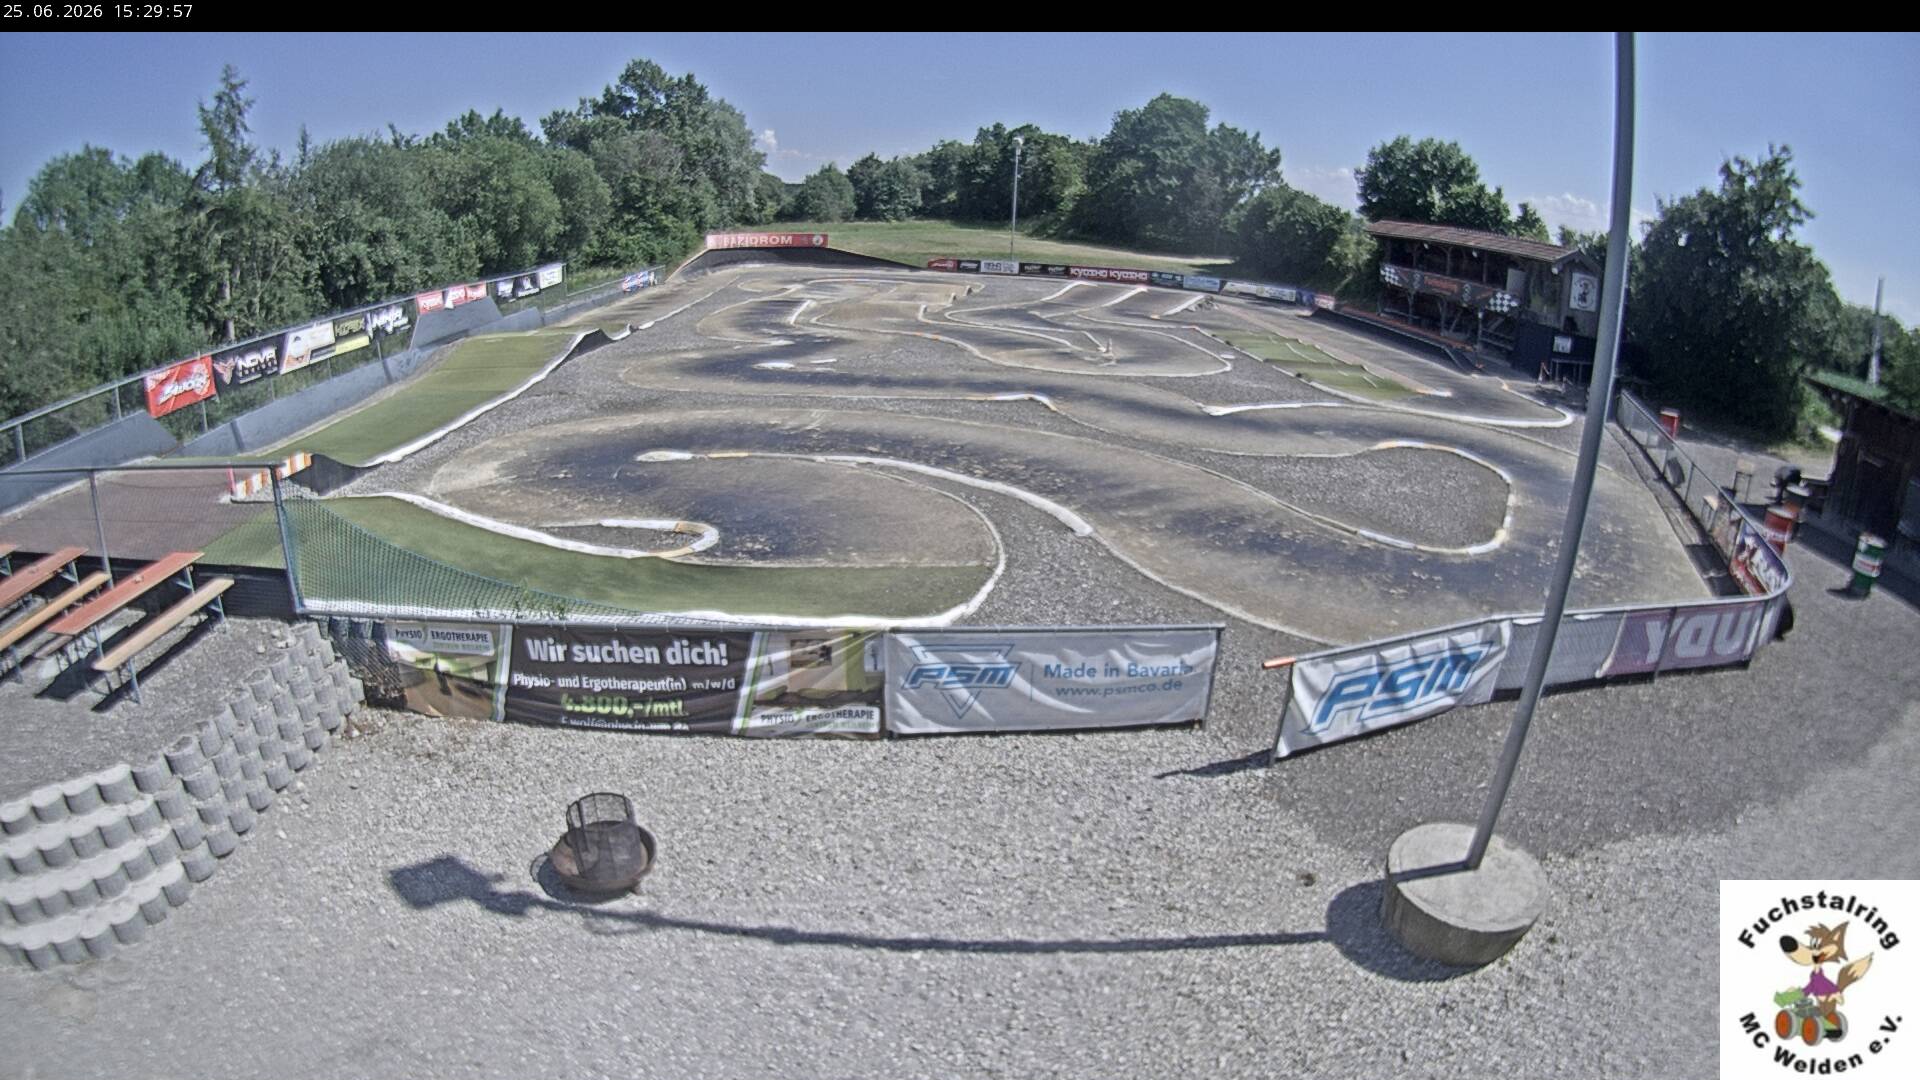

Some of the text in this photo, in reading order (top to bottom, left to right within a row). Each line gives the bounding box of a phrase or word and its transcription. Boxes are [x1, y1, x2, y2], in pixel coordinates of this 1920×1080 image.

[526, 637, 728, 666] Wir suchen dich!
[903, 661, 1022, 689] PSM
[1043, 662, 1096, 678] Made
[1104, 663, 1120, 678] in
[513, 673, 736, 693] Physio- und Ergotherapeut(in) m/w/d
[1055, 679, 1183, 698] www.psmco.de
[1305, 643, 1492, 731] PSM
